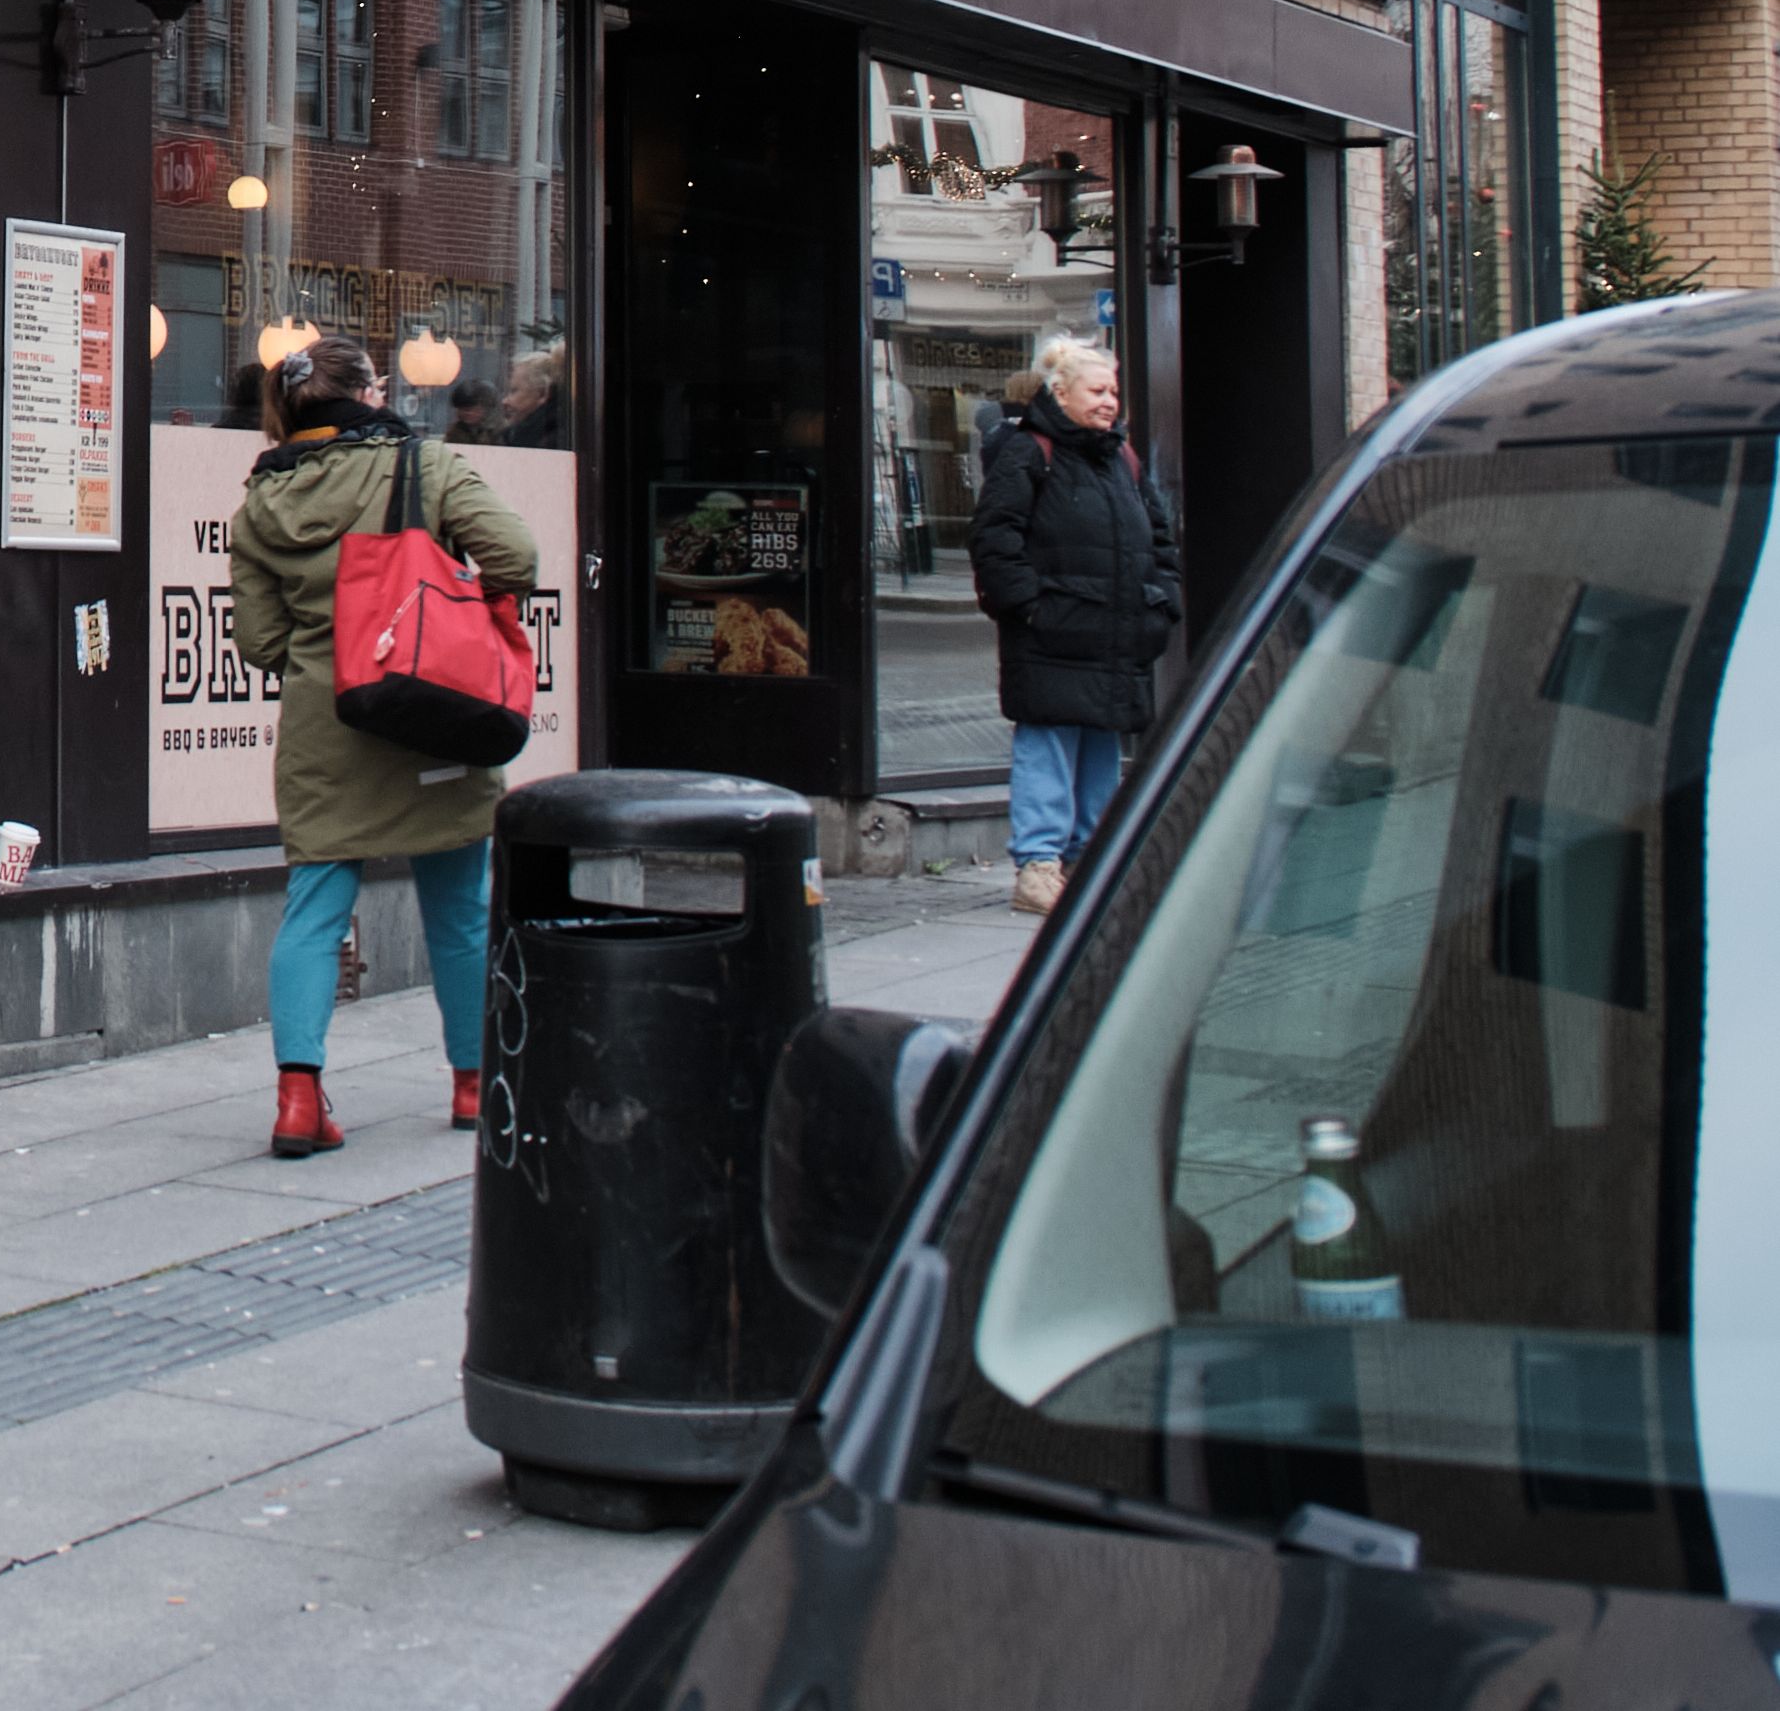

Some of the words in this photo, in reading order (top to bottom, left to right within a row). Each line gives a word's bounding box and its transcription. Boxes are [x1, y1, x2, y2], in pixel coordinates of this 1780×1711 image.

[221, 250, 510, 352] BRYGGHUSET
[751, 522, 774, 532] CAN
[751, 533, 798, 551] RIBS
[163, 728, 191, 754] BBQ
[197, 727, 205, 749] &
[210, 726, 257, 749] BRYGG
